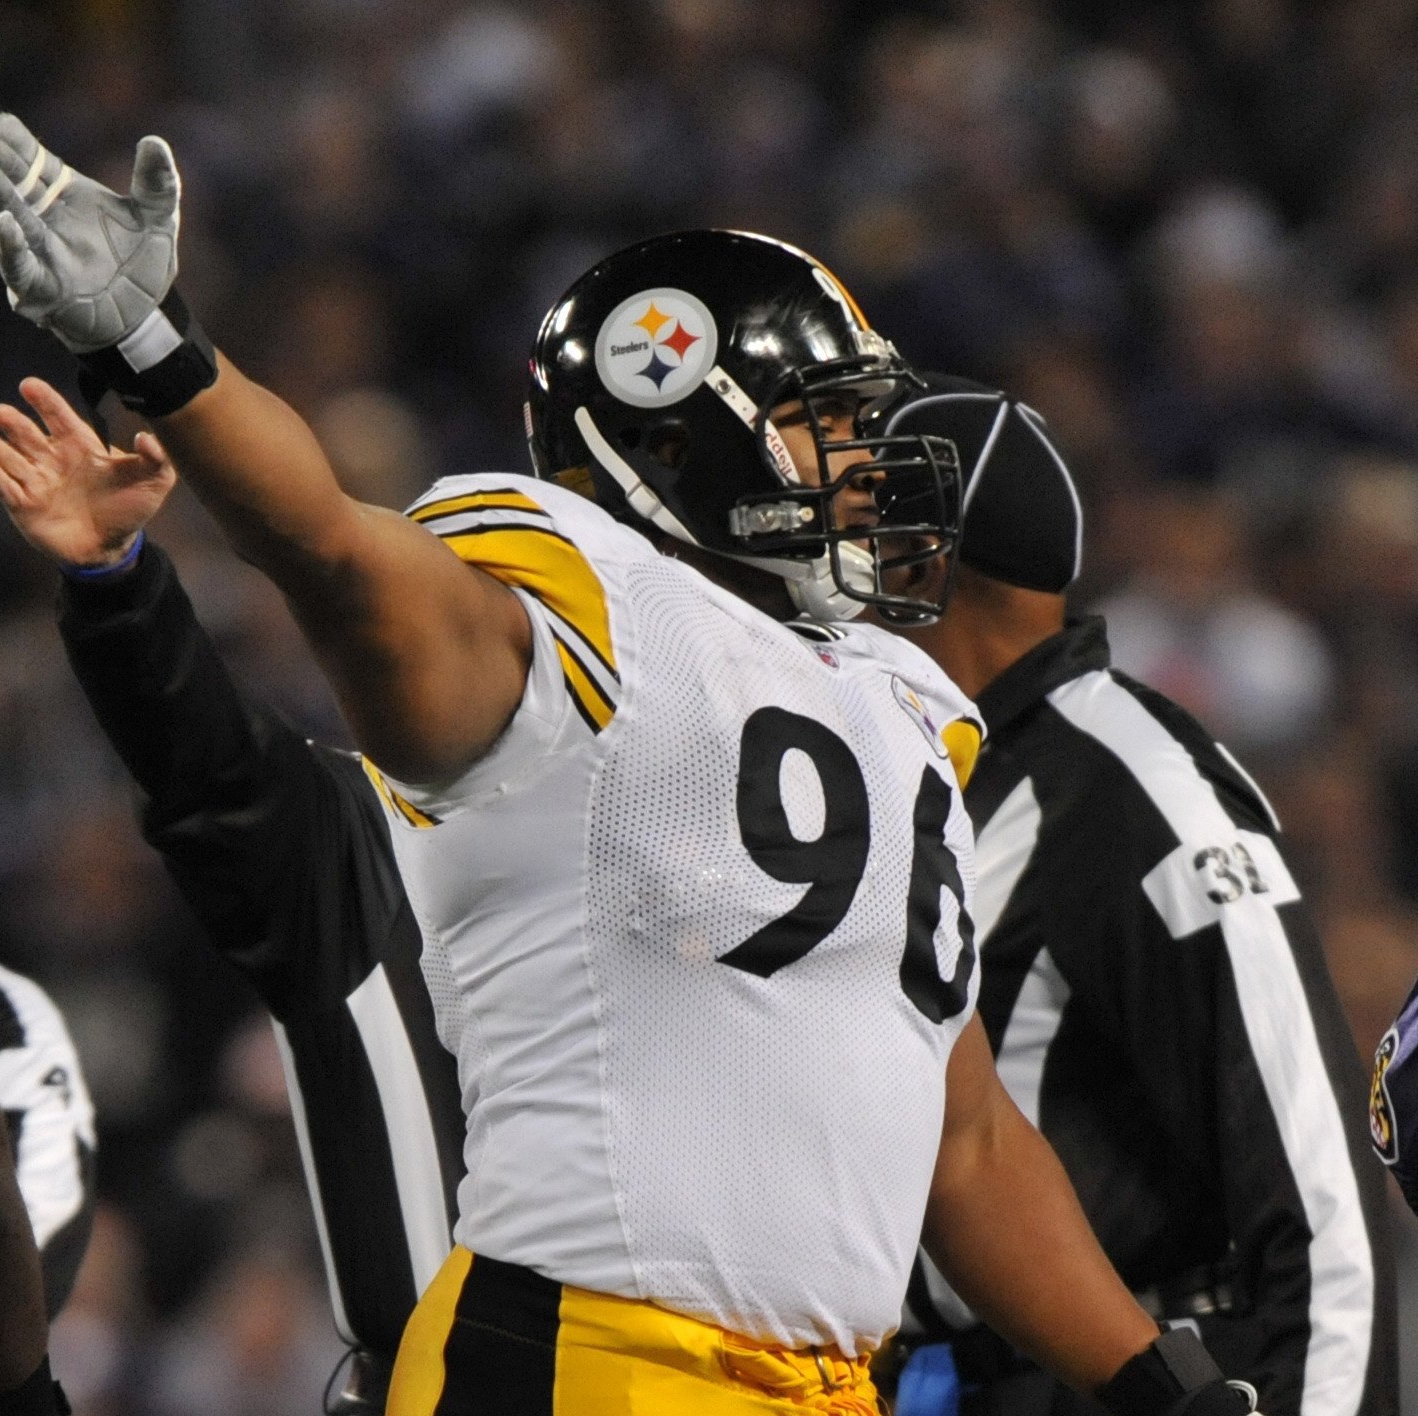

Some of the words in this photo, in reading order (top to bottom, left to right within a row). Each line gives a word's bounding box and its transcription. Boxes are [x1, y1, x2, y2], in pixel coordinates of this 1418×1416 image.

[610, 340, 650, 357] Steelers
[764, 432, 794, 476] ddell
[715, 705, 976, 1025] 96
